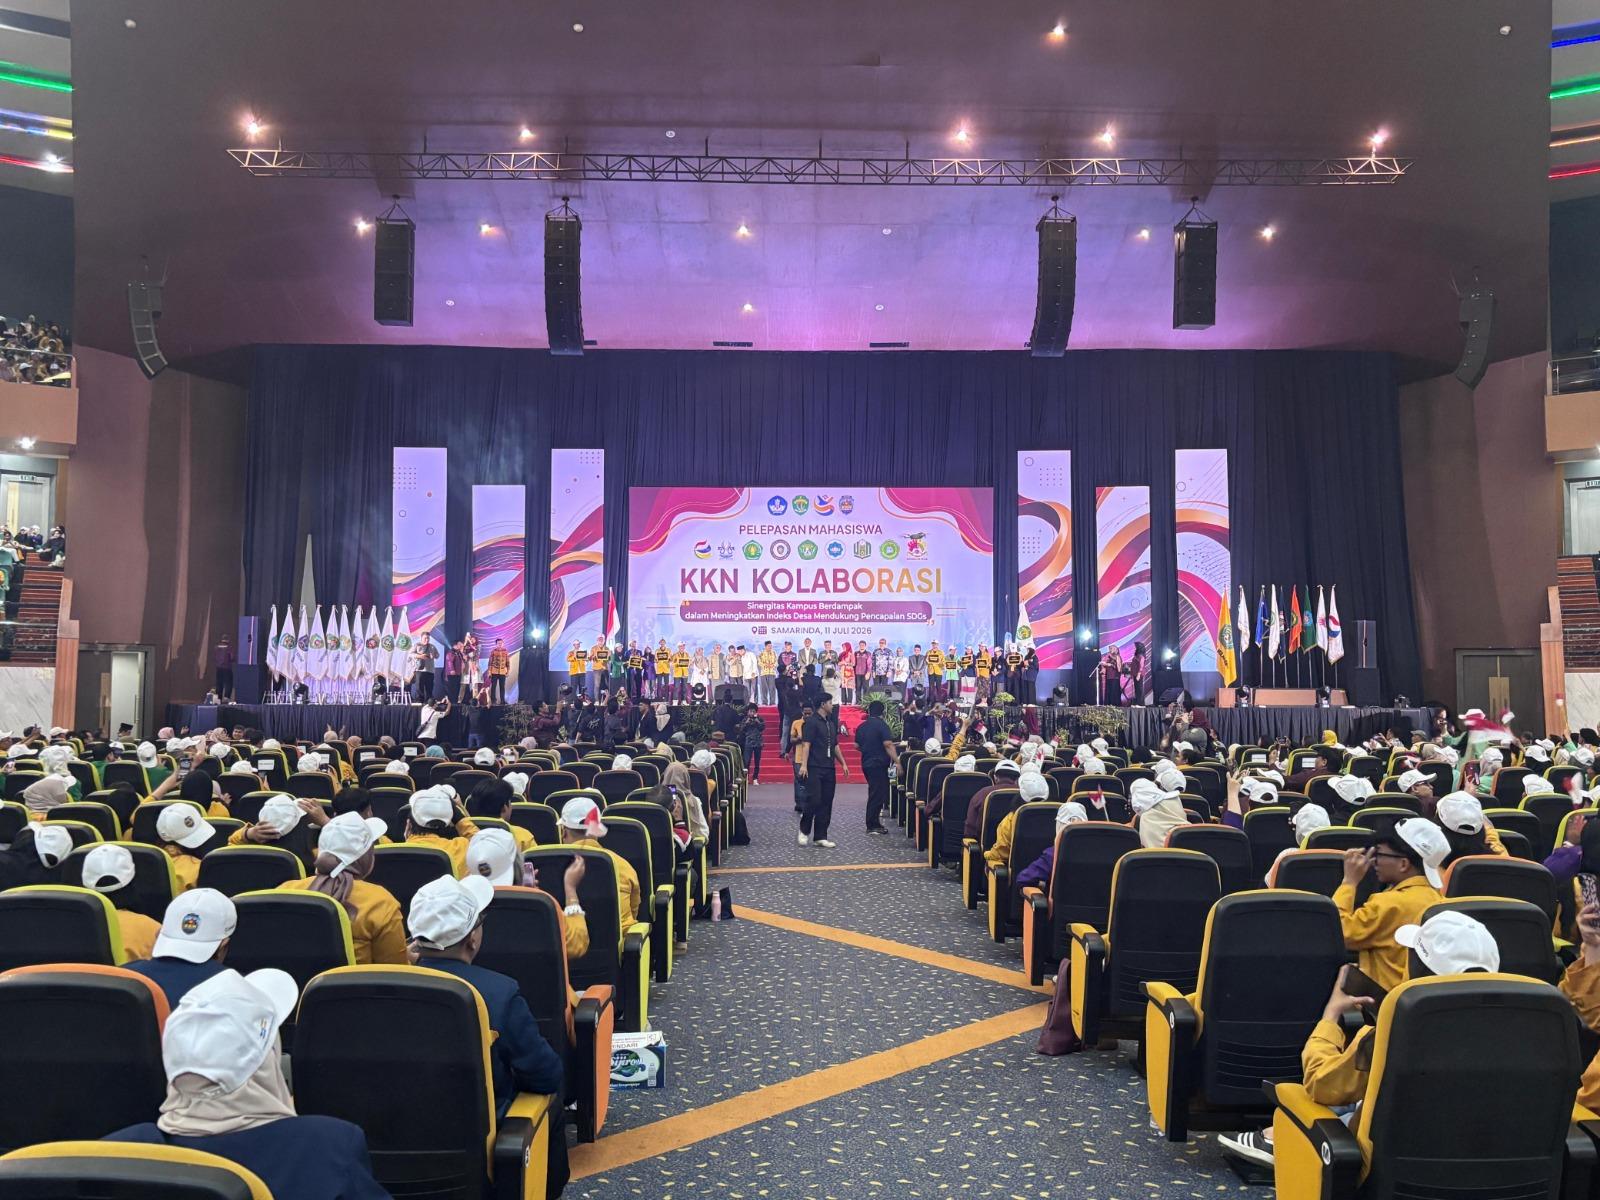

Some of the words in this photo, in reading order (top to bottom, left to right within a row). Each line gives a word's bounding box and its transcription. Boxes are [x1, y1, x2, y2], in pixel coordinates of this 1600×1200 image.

[739, 525, 806, 535] PELEPASAN
[809, 525, 882, 535] MAHASISWA
[680, 568, 739, 593] KKN
[752, 568, 941, 593] KOLABORASI
[747, 602, 784, 611] Sinergitas
[786, 602, 818, 611] Kampus
[819, 602, 863, 611] Berdampak
[685, 612, 709, 620] dalam
[711, 612, 765, 621] Meningkatkan
[767, 612, 792, 620] Indeks
[794, 612, 812, 620] Desa
[814, 612, 859, 621] Mendukung
[861, 612, 904, 621] Pencapaian
[906, 612, 927, 620] SDGs
[771, 627, 823, 636] SAMARINDA,
[833, 627, 850, 635] JULI
[852, 627, 872, 635] 2026
